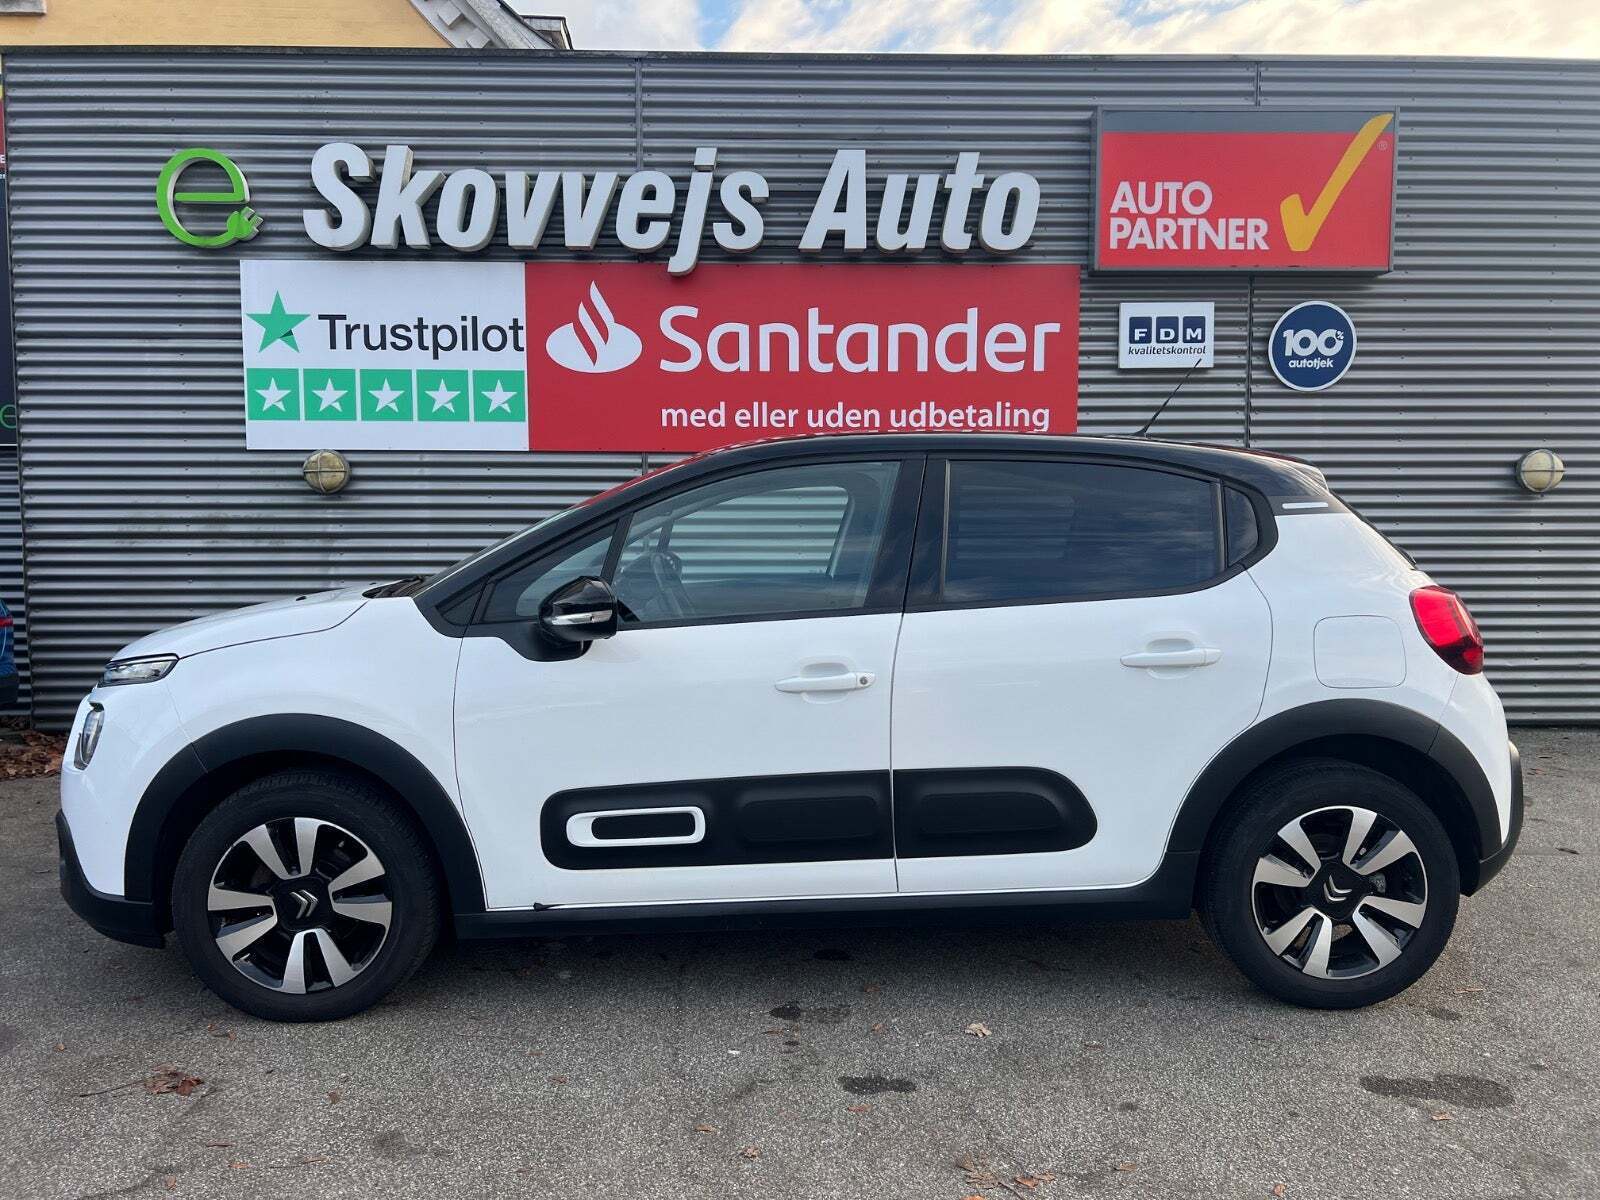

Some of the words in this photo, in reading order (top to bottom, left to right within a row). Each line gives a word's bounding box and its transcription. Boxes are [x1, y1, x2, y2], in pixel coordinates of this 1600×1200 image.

[303, 143, 770, 276] Skovvejs
[799, 149, 1041, 252] Auto
[1110, 181, 1213, 215] AUTO
[1110, 218, 1271, 250] PARTNER
[318, 313, 525, 360] Trustpilot
[659, 306, 1061, 373] Santander
[1134, 327, 1202, 341] FDM
[1128, 346, 1206, 355] kvalitetskontrol
[1288, 358, 1334, 370] autotjek
[661, 402, 726, 428] med
[735, 402, 798, 428] eller
[807, 402, 880, 428] uden
[890, 402, 1050, 432] udbetaling
